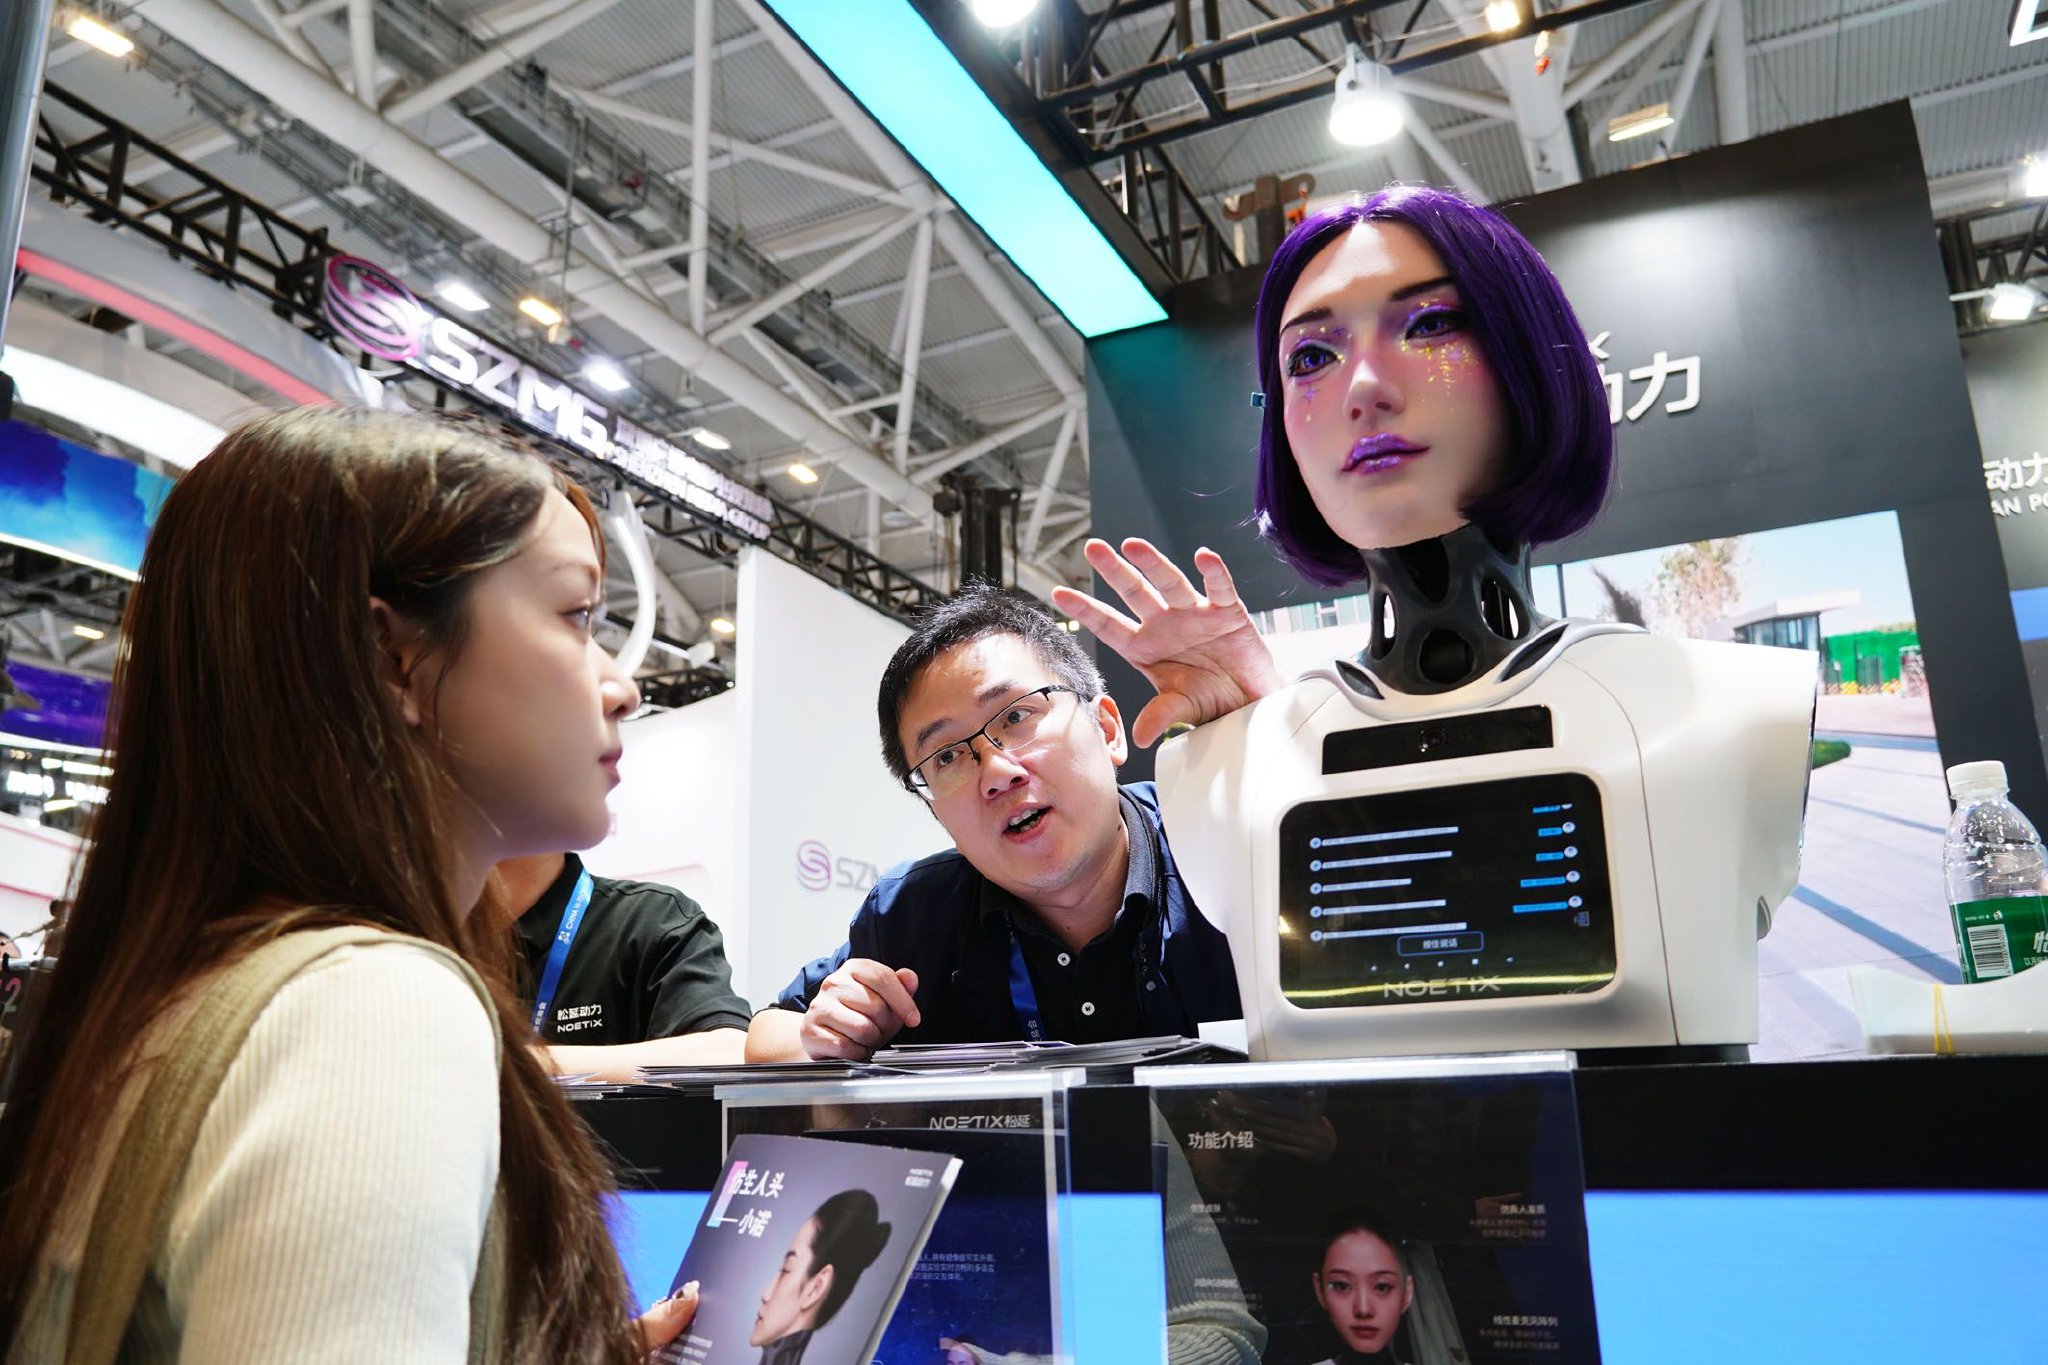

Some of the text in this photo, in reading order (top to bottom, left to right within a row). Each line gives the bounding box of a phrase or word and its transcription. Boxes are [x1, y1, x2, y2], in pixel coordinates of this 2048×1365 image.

[836, 857, 880, 893] SZ
[1384, 975, 1501, 998] NOETIX
[557, 1004, 602, 1021] 松延动力
[557, 1018, 603, 1033] NOETIX
[1188, 1130, 1254, 1150] 功能介绍
